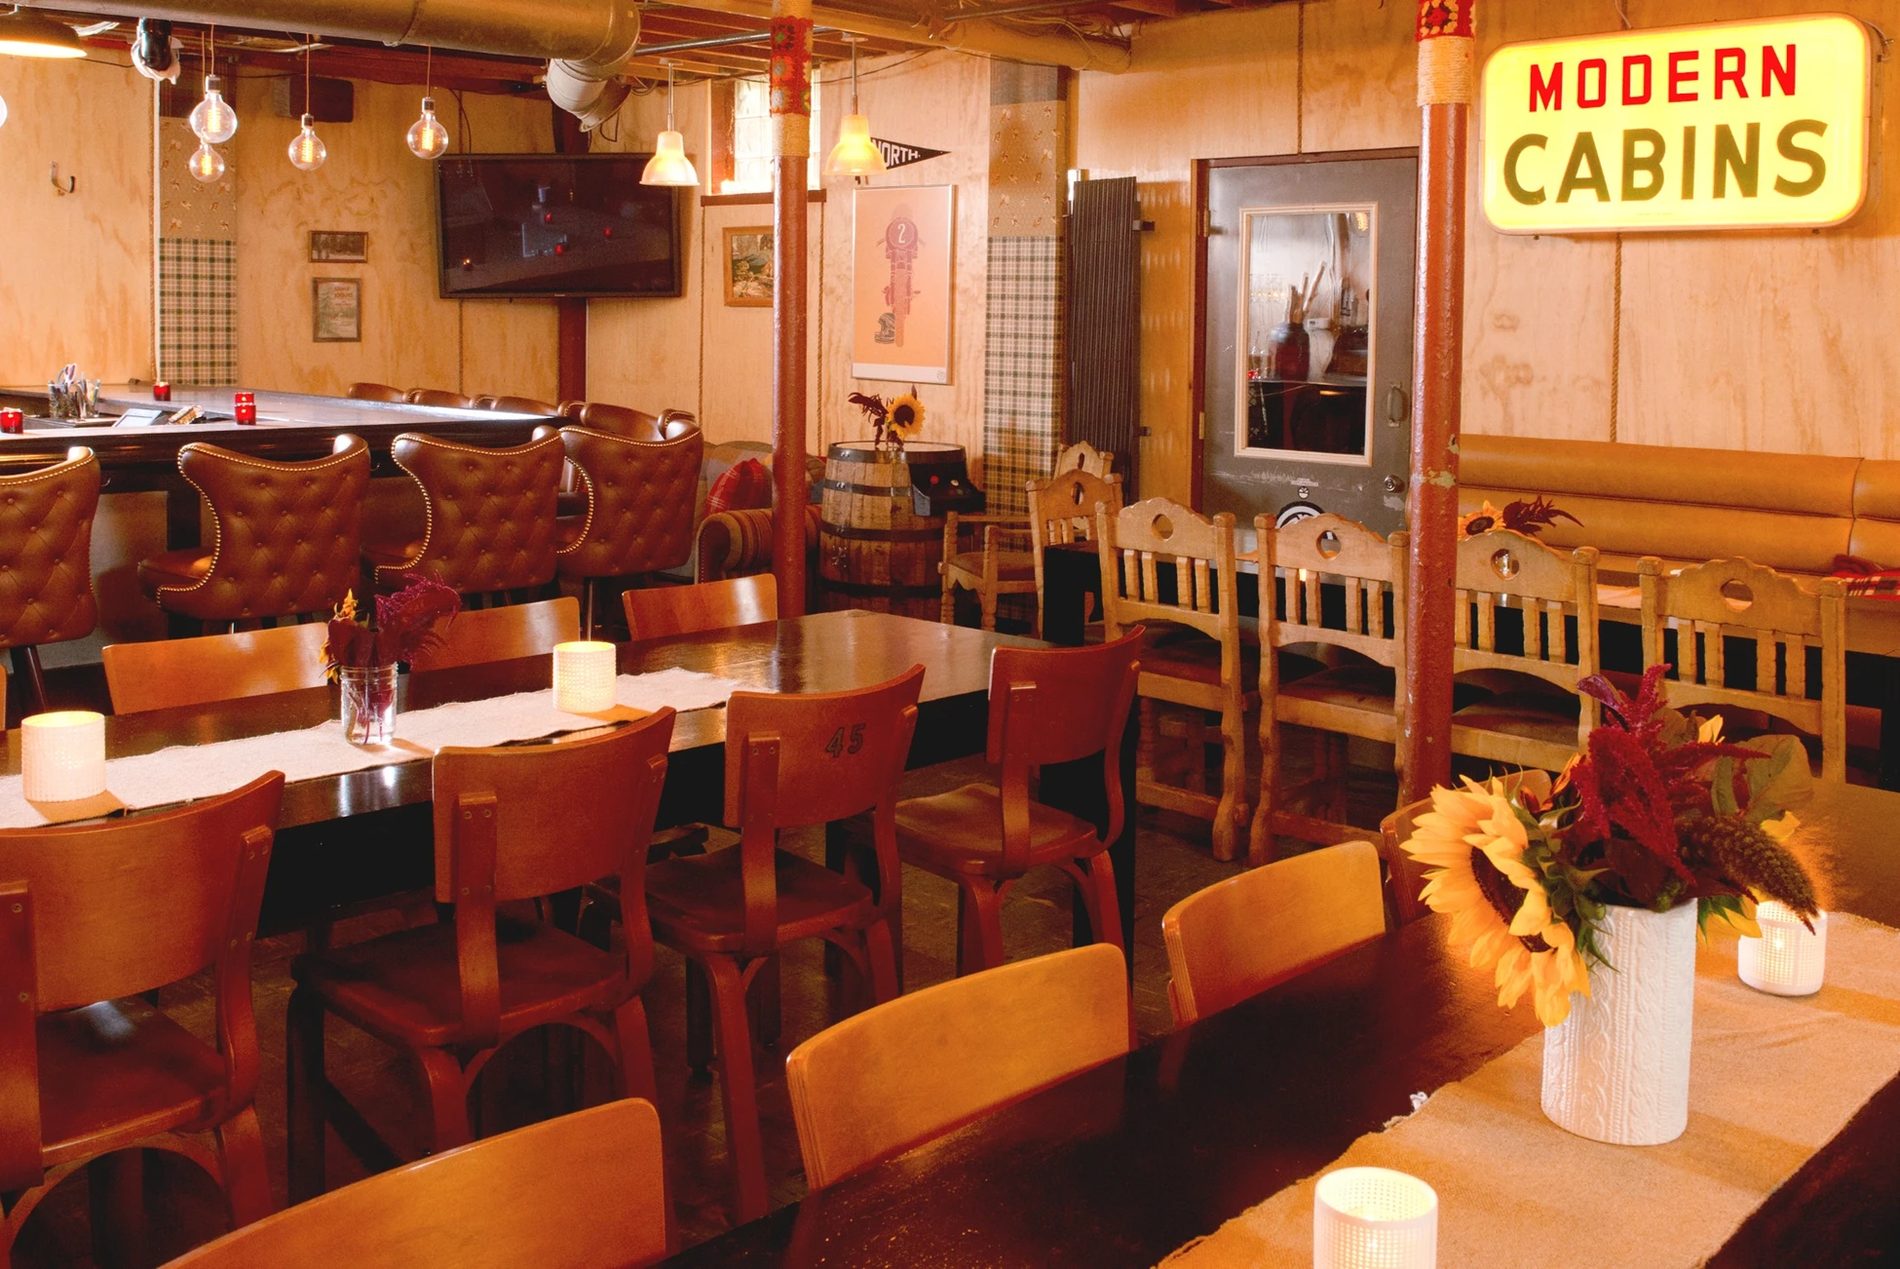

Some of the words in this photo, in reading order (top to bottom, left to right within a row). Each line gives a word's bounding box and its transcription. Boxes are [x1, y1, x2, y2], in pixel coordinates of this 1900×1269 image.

[1529, 43, 1796, 113] MODERN
[1503, 119, 1829, 206] CABINS
[897, 223, 906, 244] 2
[825, 722, 866, 758] 45
